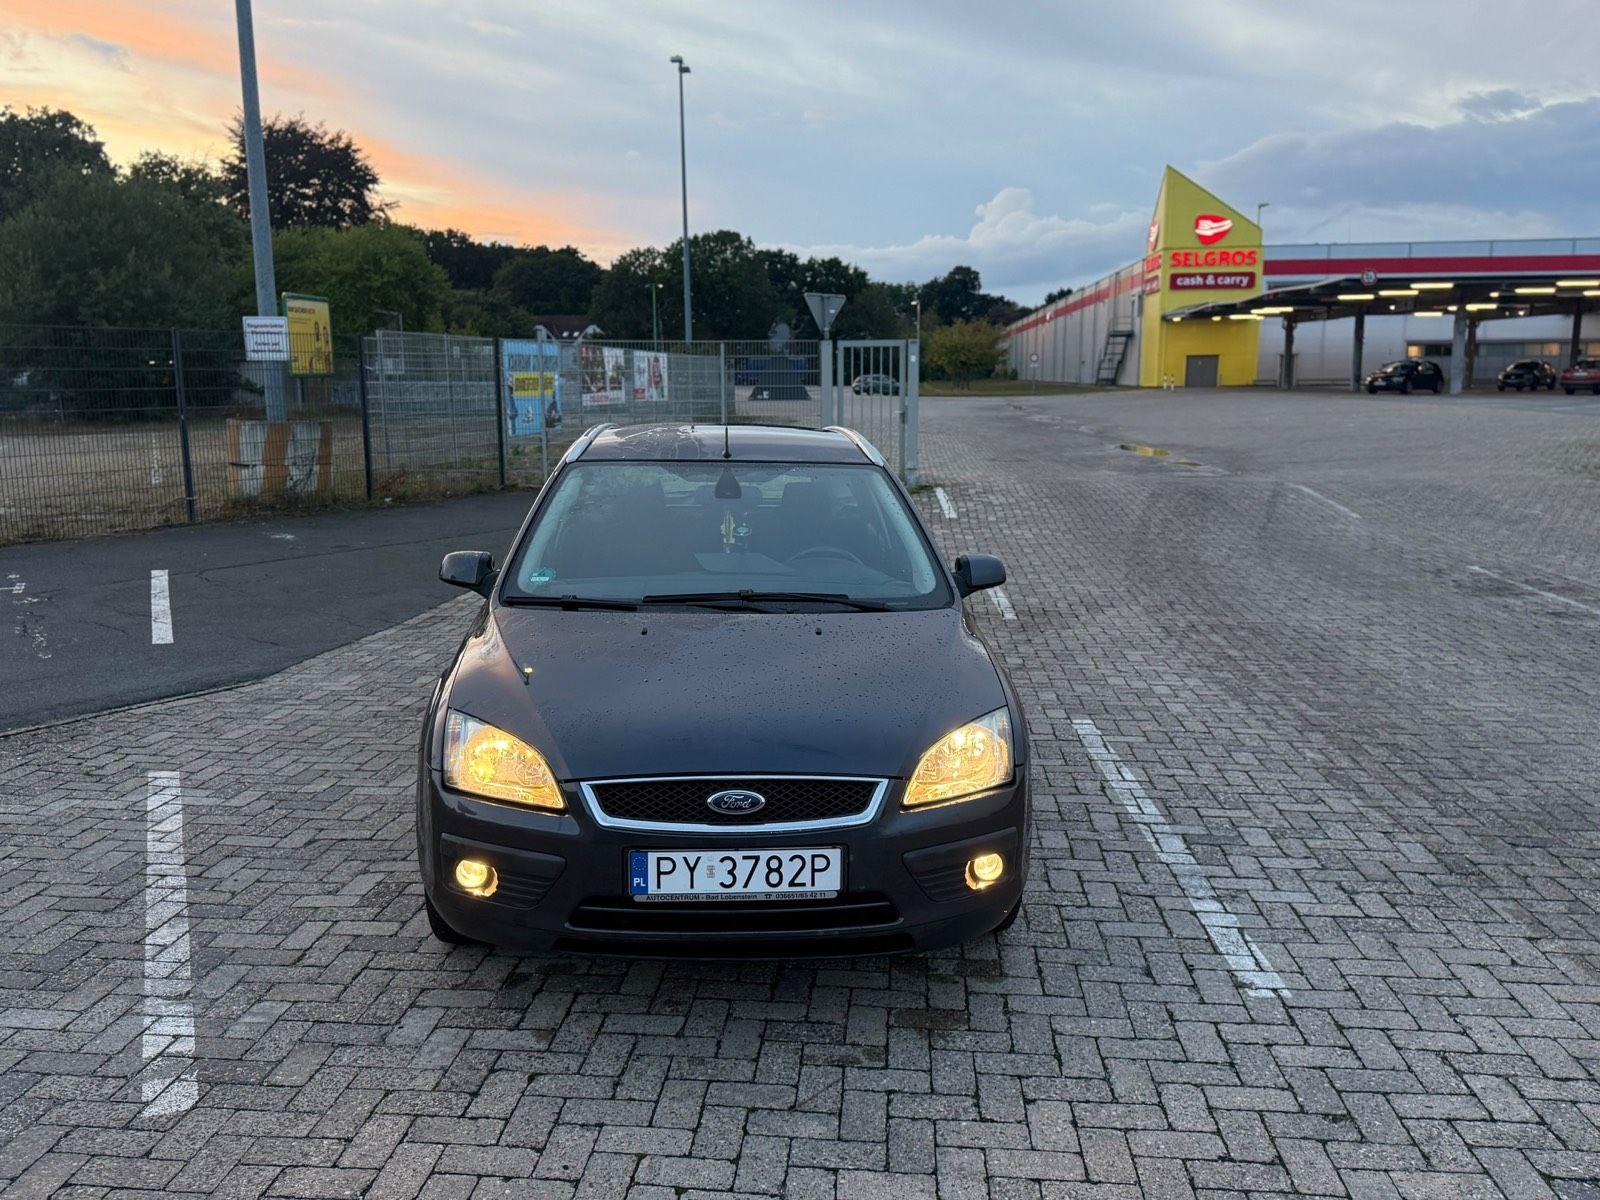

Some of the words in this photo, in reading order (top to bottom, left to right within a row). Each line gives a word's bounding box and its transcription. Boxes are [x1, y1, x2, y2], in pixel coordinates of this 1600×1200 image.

[1171, 250, 1257, 266] SELGROS
[1177, 275, 1203, 285] cash
[1206, 275, 1215, 285] &
[1217, 276, 1249, 287] carry
[720, 794, 752, 810] Ford
[656, 856, 702, 889] PY
[718, 854, 831, 890] 3782P
[633, 877, 647, 887] PL
[720, 893, 757, 901] Lobenstein
